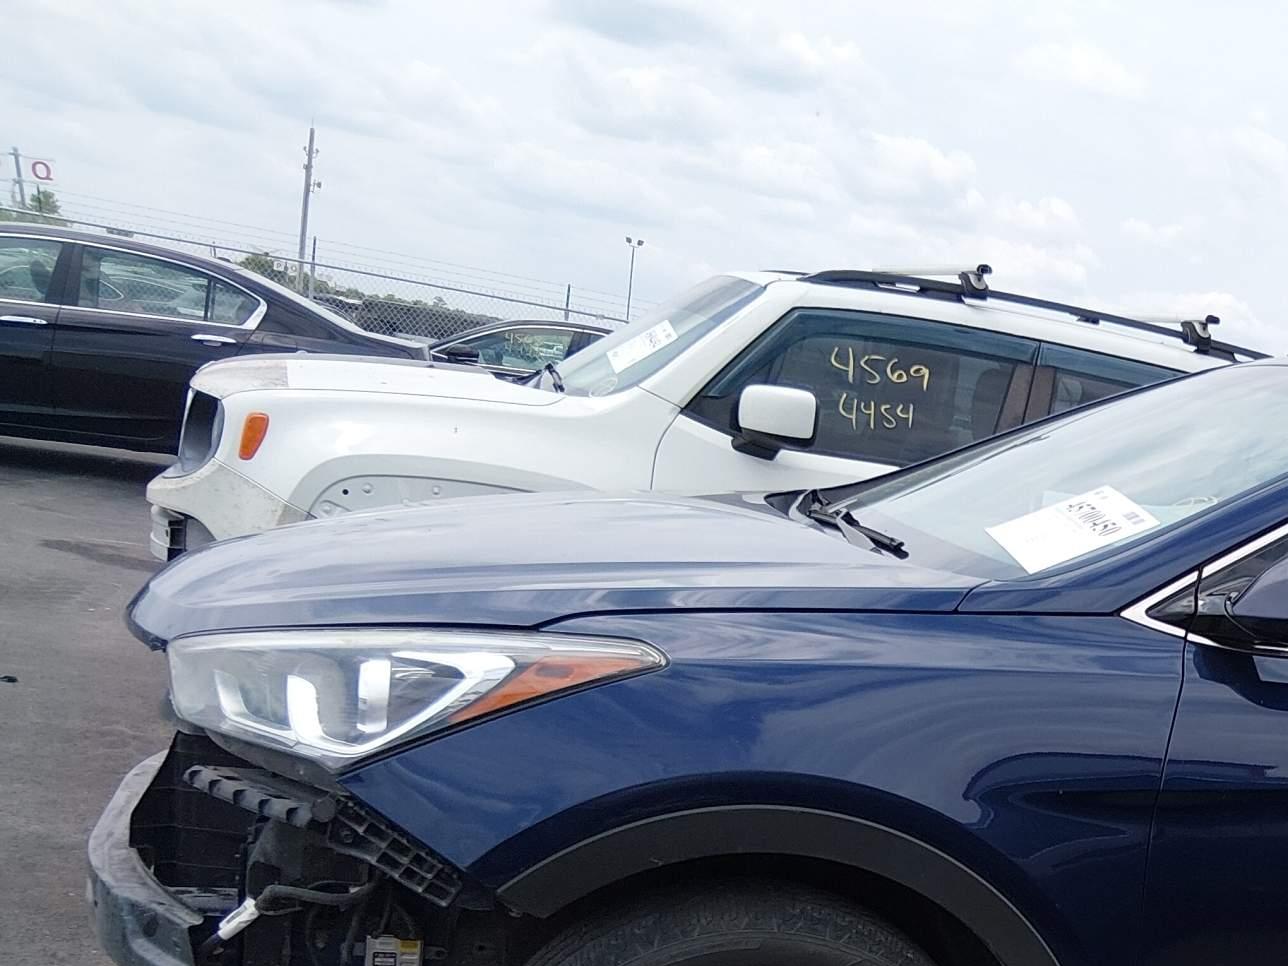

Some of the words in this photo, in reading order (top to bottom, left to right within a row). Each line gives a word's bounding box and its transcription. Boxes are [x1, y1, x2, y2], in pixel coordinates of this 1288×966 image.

[32, 161, 54, 181] Q
[831, 346, 929, 391] 4569
[839, 392, 913, 431] 4454
[1066, 501, 1122, 537] 45700450
